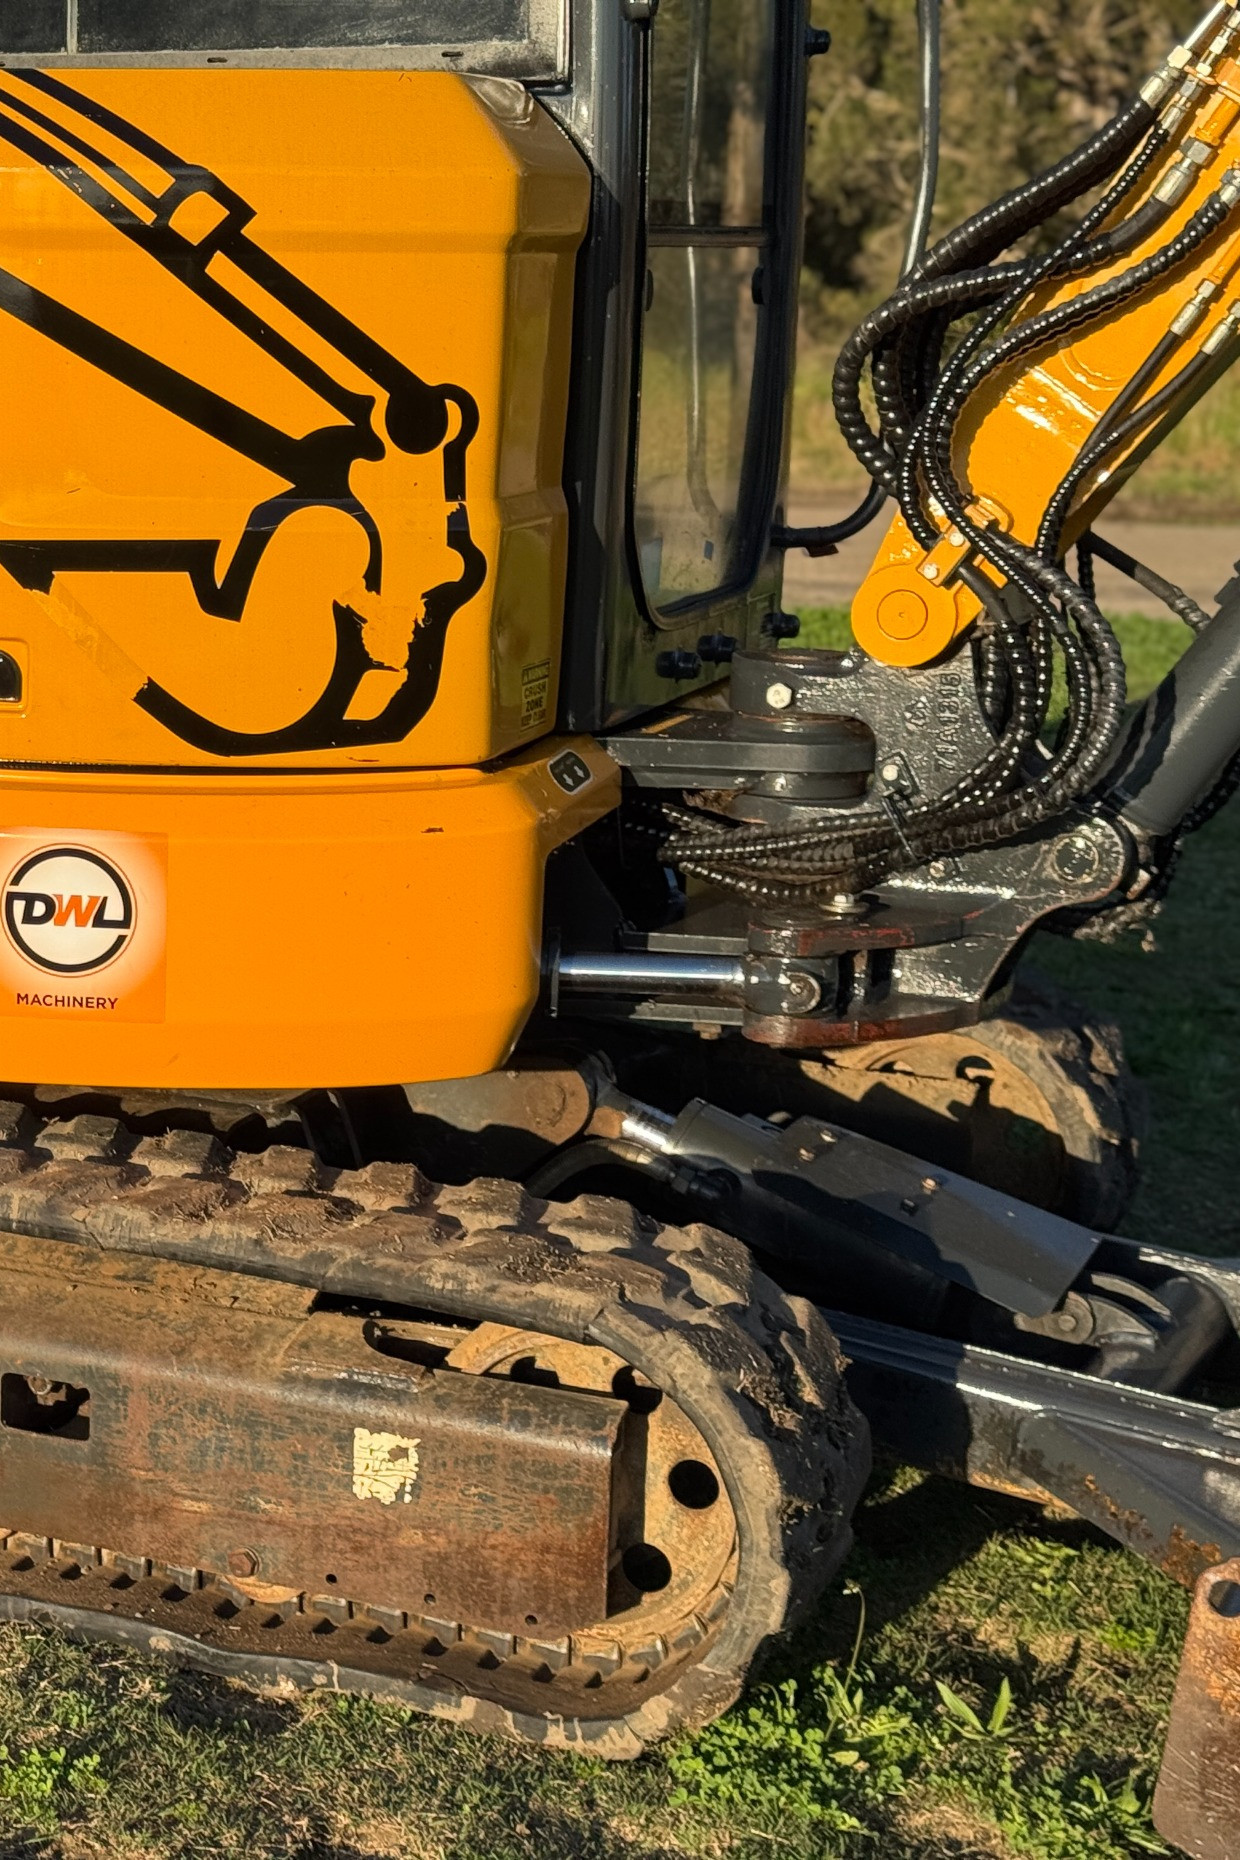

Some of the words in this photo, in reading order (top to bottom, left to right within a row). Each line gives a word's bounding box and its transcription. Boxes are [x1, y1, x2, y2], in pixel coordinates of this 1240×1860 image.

[524, 681, 546, 698] CRUSH
[525, 699, 543, 713] ZONE
[5, 891, 131, 930] DWL
[16, 992, 119, 1010] MACHINERY
